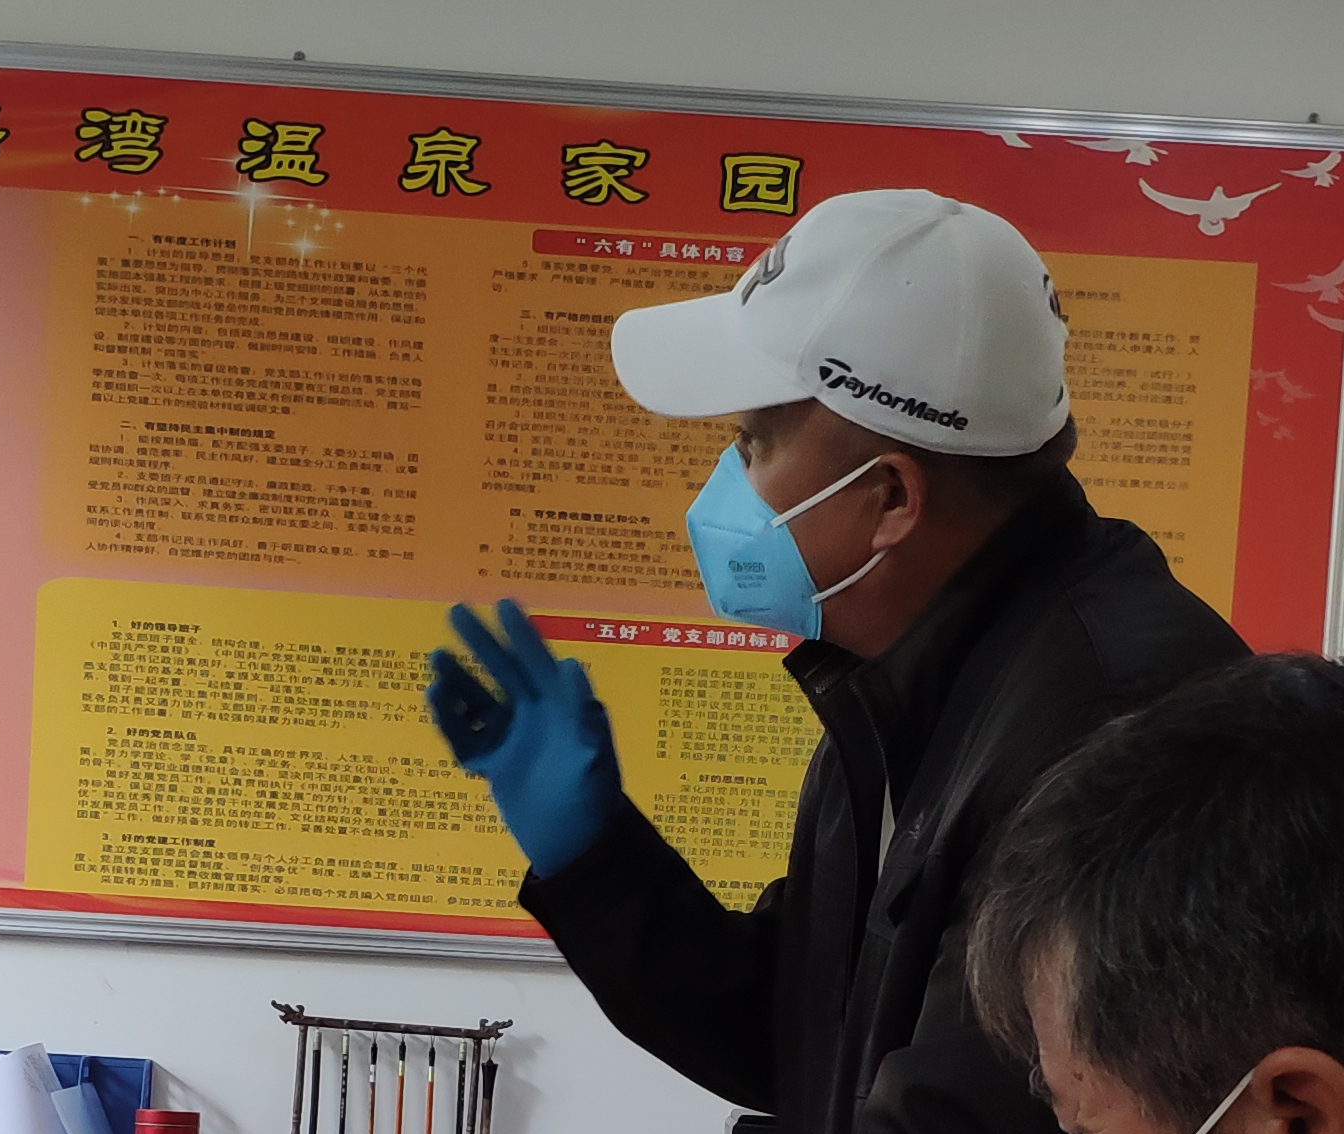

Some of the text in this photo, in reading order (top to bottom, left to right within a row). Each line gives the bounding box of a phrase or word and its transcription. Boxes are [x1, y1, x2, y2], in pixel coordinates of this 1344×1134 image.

[818, 356, 970, 431] TaylorMade
[584, 622, 790, 650] “五好”党支部的标准
